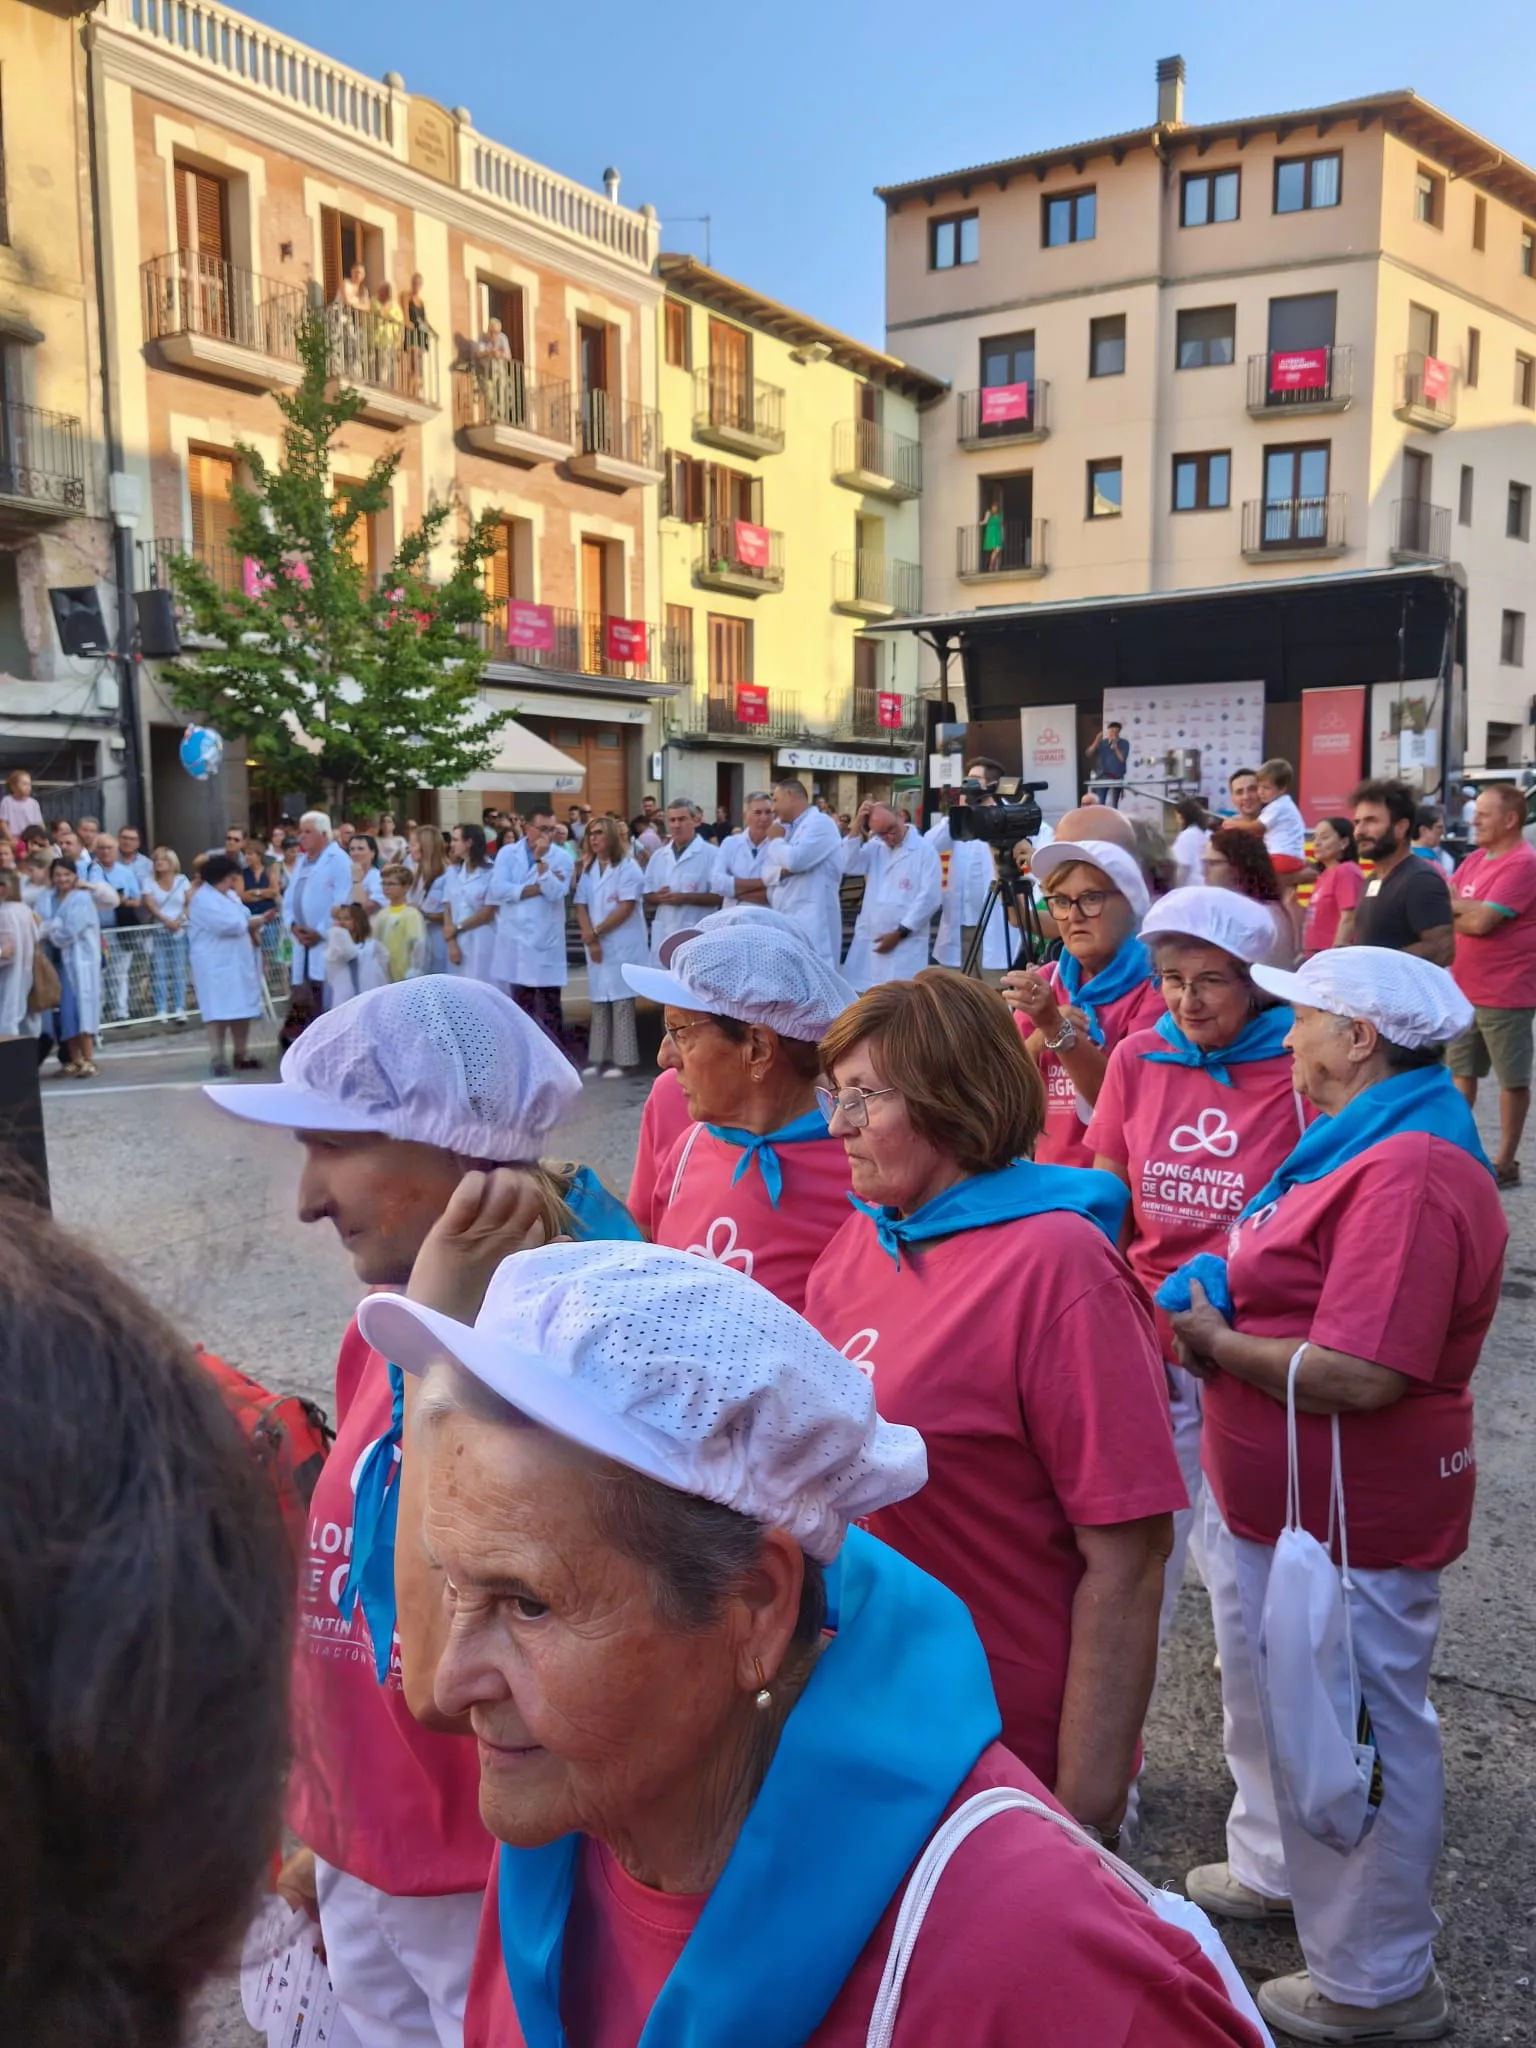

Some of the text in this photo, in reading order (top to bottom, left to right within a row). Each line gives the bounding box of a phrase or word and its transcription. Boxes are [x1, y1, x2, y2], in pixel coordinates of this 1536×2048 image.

[808, 752, 870, 770] CALZADOS
[1143, 1159, 1245, 1189] LONGANIZA
[1142, 1179, 1244, 1211] DE GRAUS
[1439, 1446, 1474, 1479] LON
